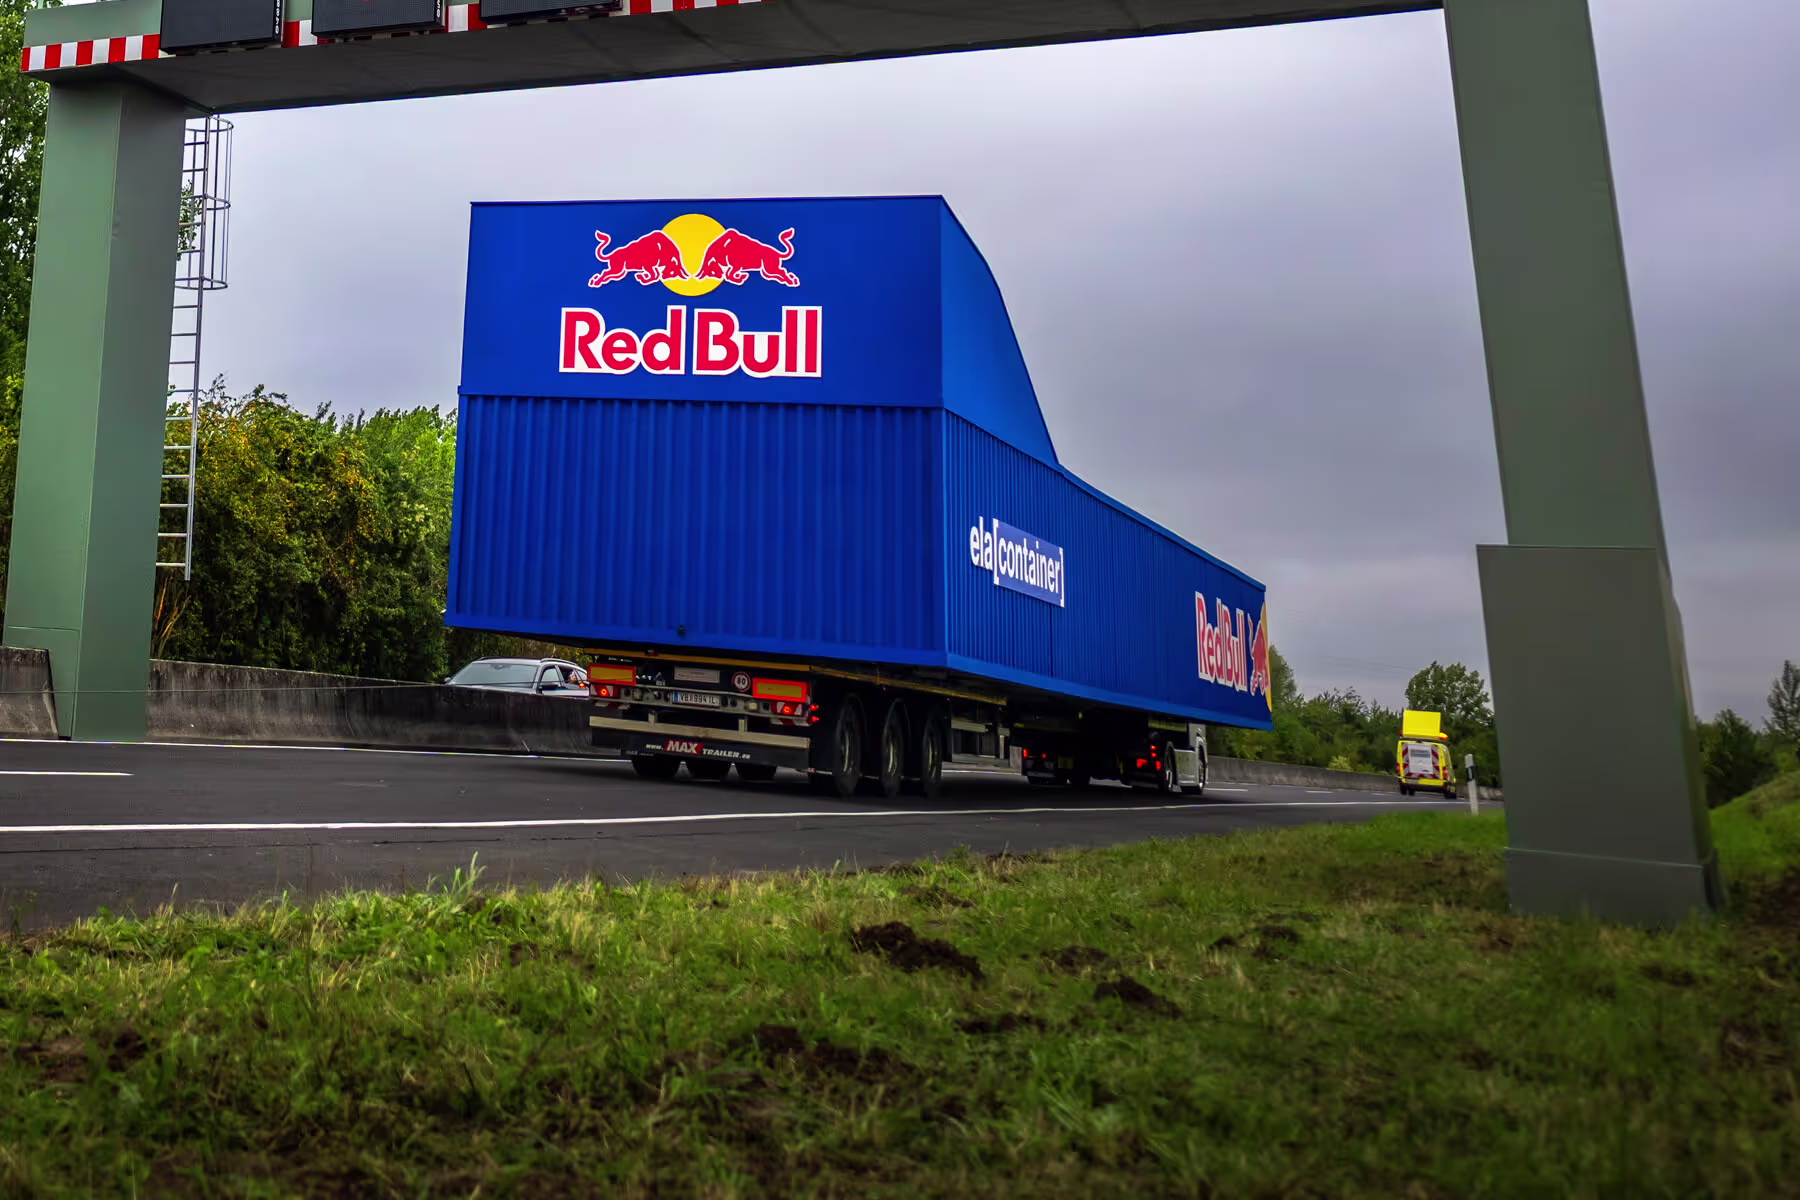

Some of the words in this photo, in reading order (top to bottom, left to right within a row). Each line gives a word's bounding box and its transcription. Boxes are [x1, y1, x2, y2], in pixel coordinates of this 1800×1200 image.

[562, 308, 684, 372] Red
[694, 308, 819, 374] Bull
[1196, 593, 1224, 681] Red
[1222, 605, 1247, 690] Bull
